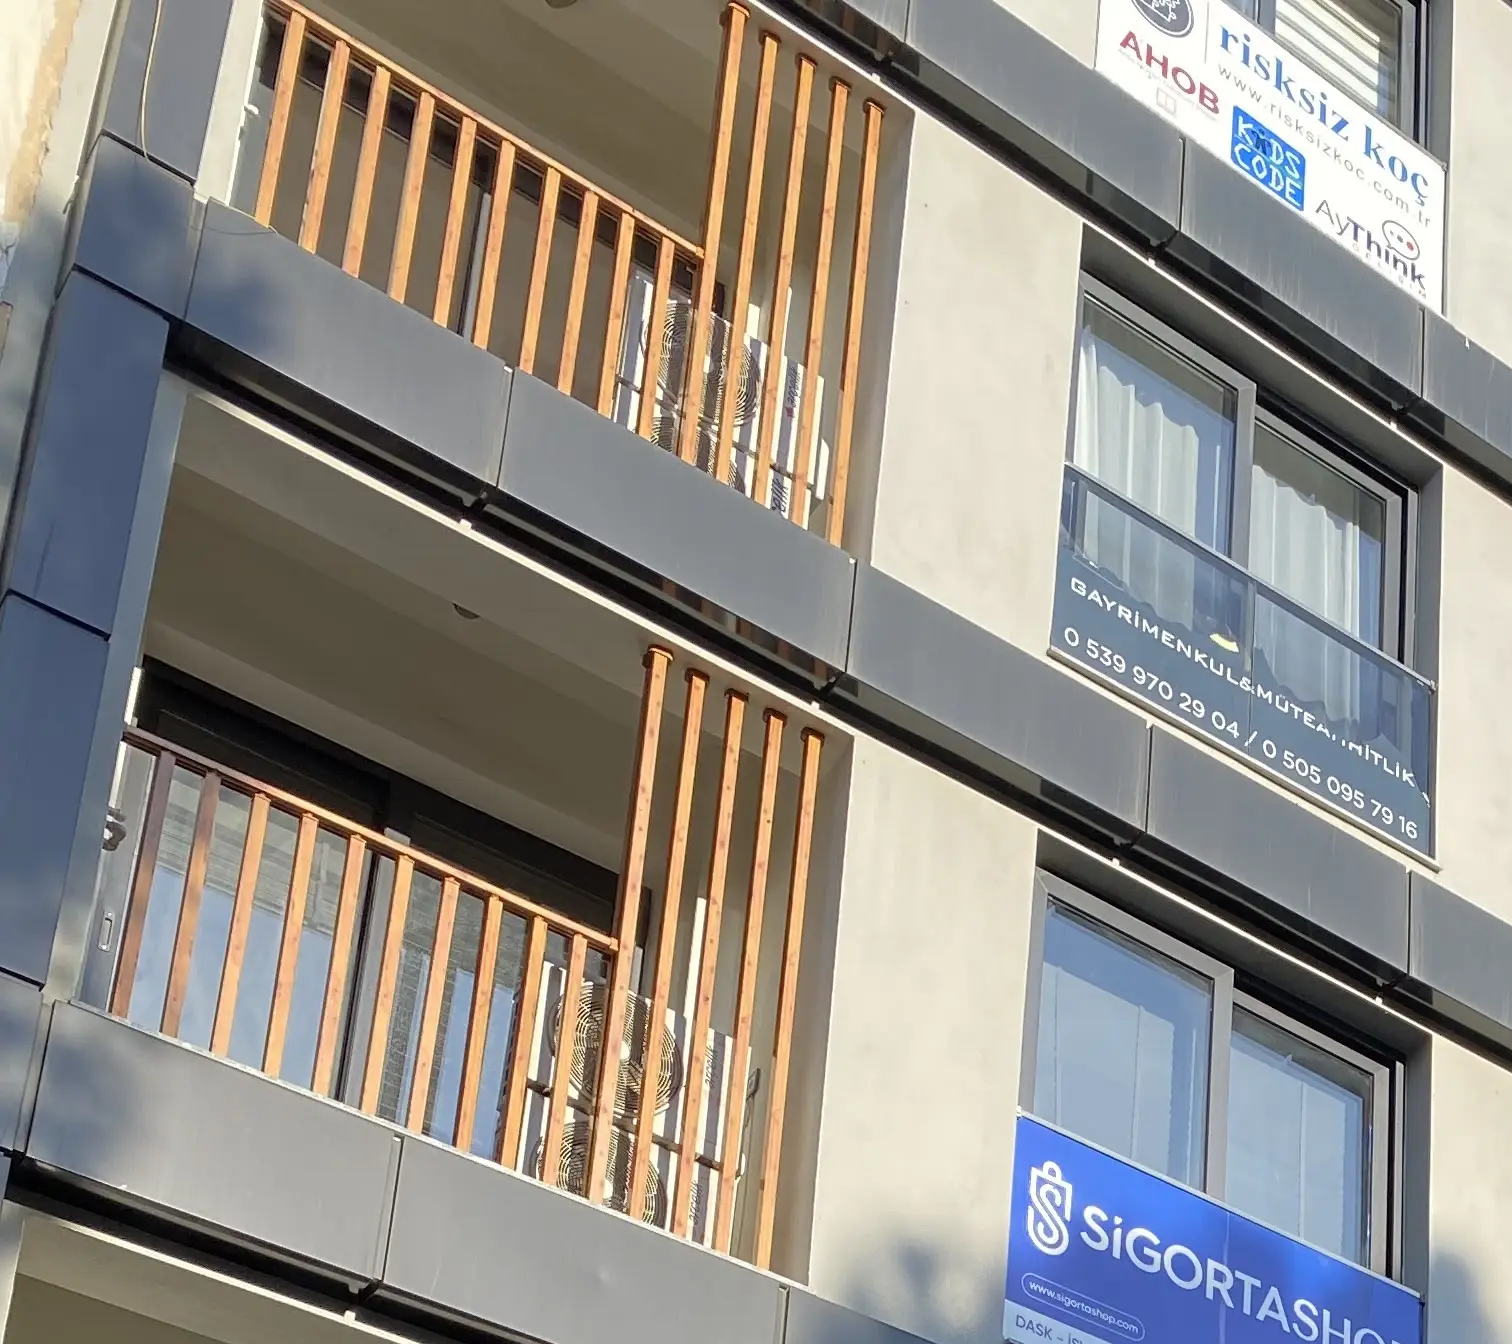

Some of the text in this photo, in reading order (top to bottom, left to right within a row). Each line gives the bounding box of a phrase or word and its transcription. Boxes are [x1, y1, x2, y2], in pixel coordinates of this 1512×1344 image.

[1119, 30, 1220, 115] AHOB
[1217, 62, 1431, 229] www.risksizkoc.com.tr
[1219, 24, 1349, 142] risksiz
[1363, 123, 1431, 207] koç
[1233, 144, 1302, 206] CODE
[1064, 626, 1080, 648] 0
[1086, 640, 1127, 675] 539
[1132, 664, 1174, 702] 970
[1178, 691, 1206, 720] 29
[1211, 710, 1240, 739] 04
[1262, 738, 1277, 759] 0
[1282, 750, 1321, 786] 505
[1327, 775, 1365, 810] 095
[1370, 798, 1394, 825] 79
[1398, 815, 1418, 840] 16
[1015, 1314, 1053, 1341] DASK
[1028, 1280, 1140, 1335] www.sigortashop.com
